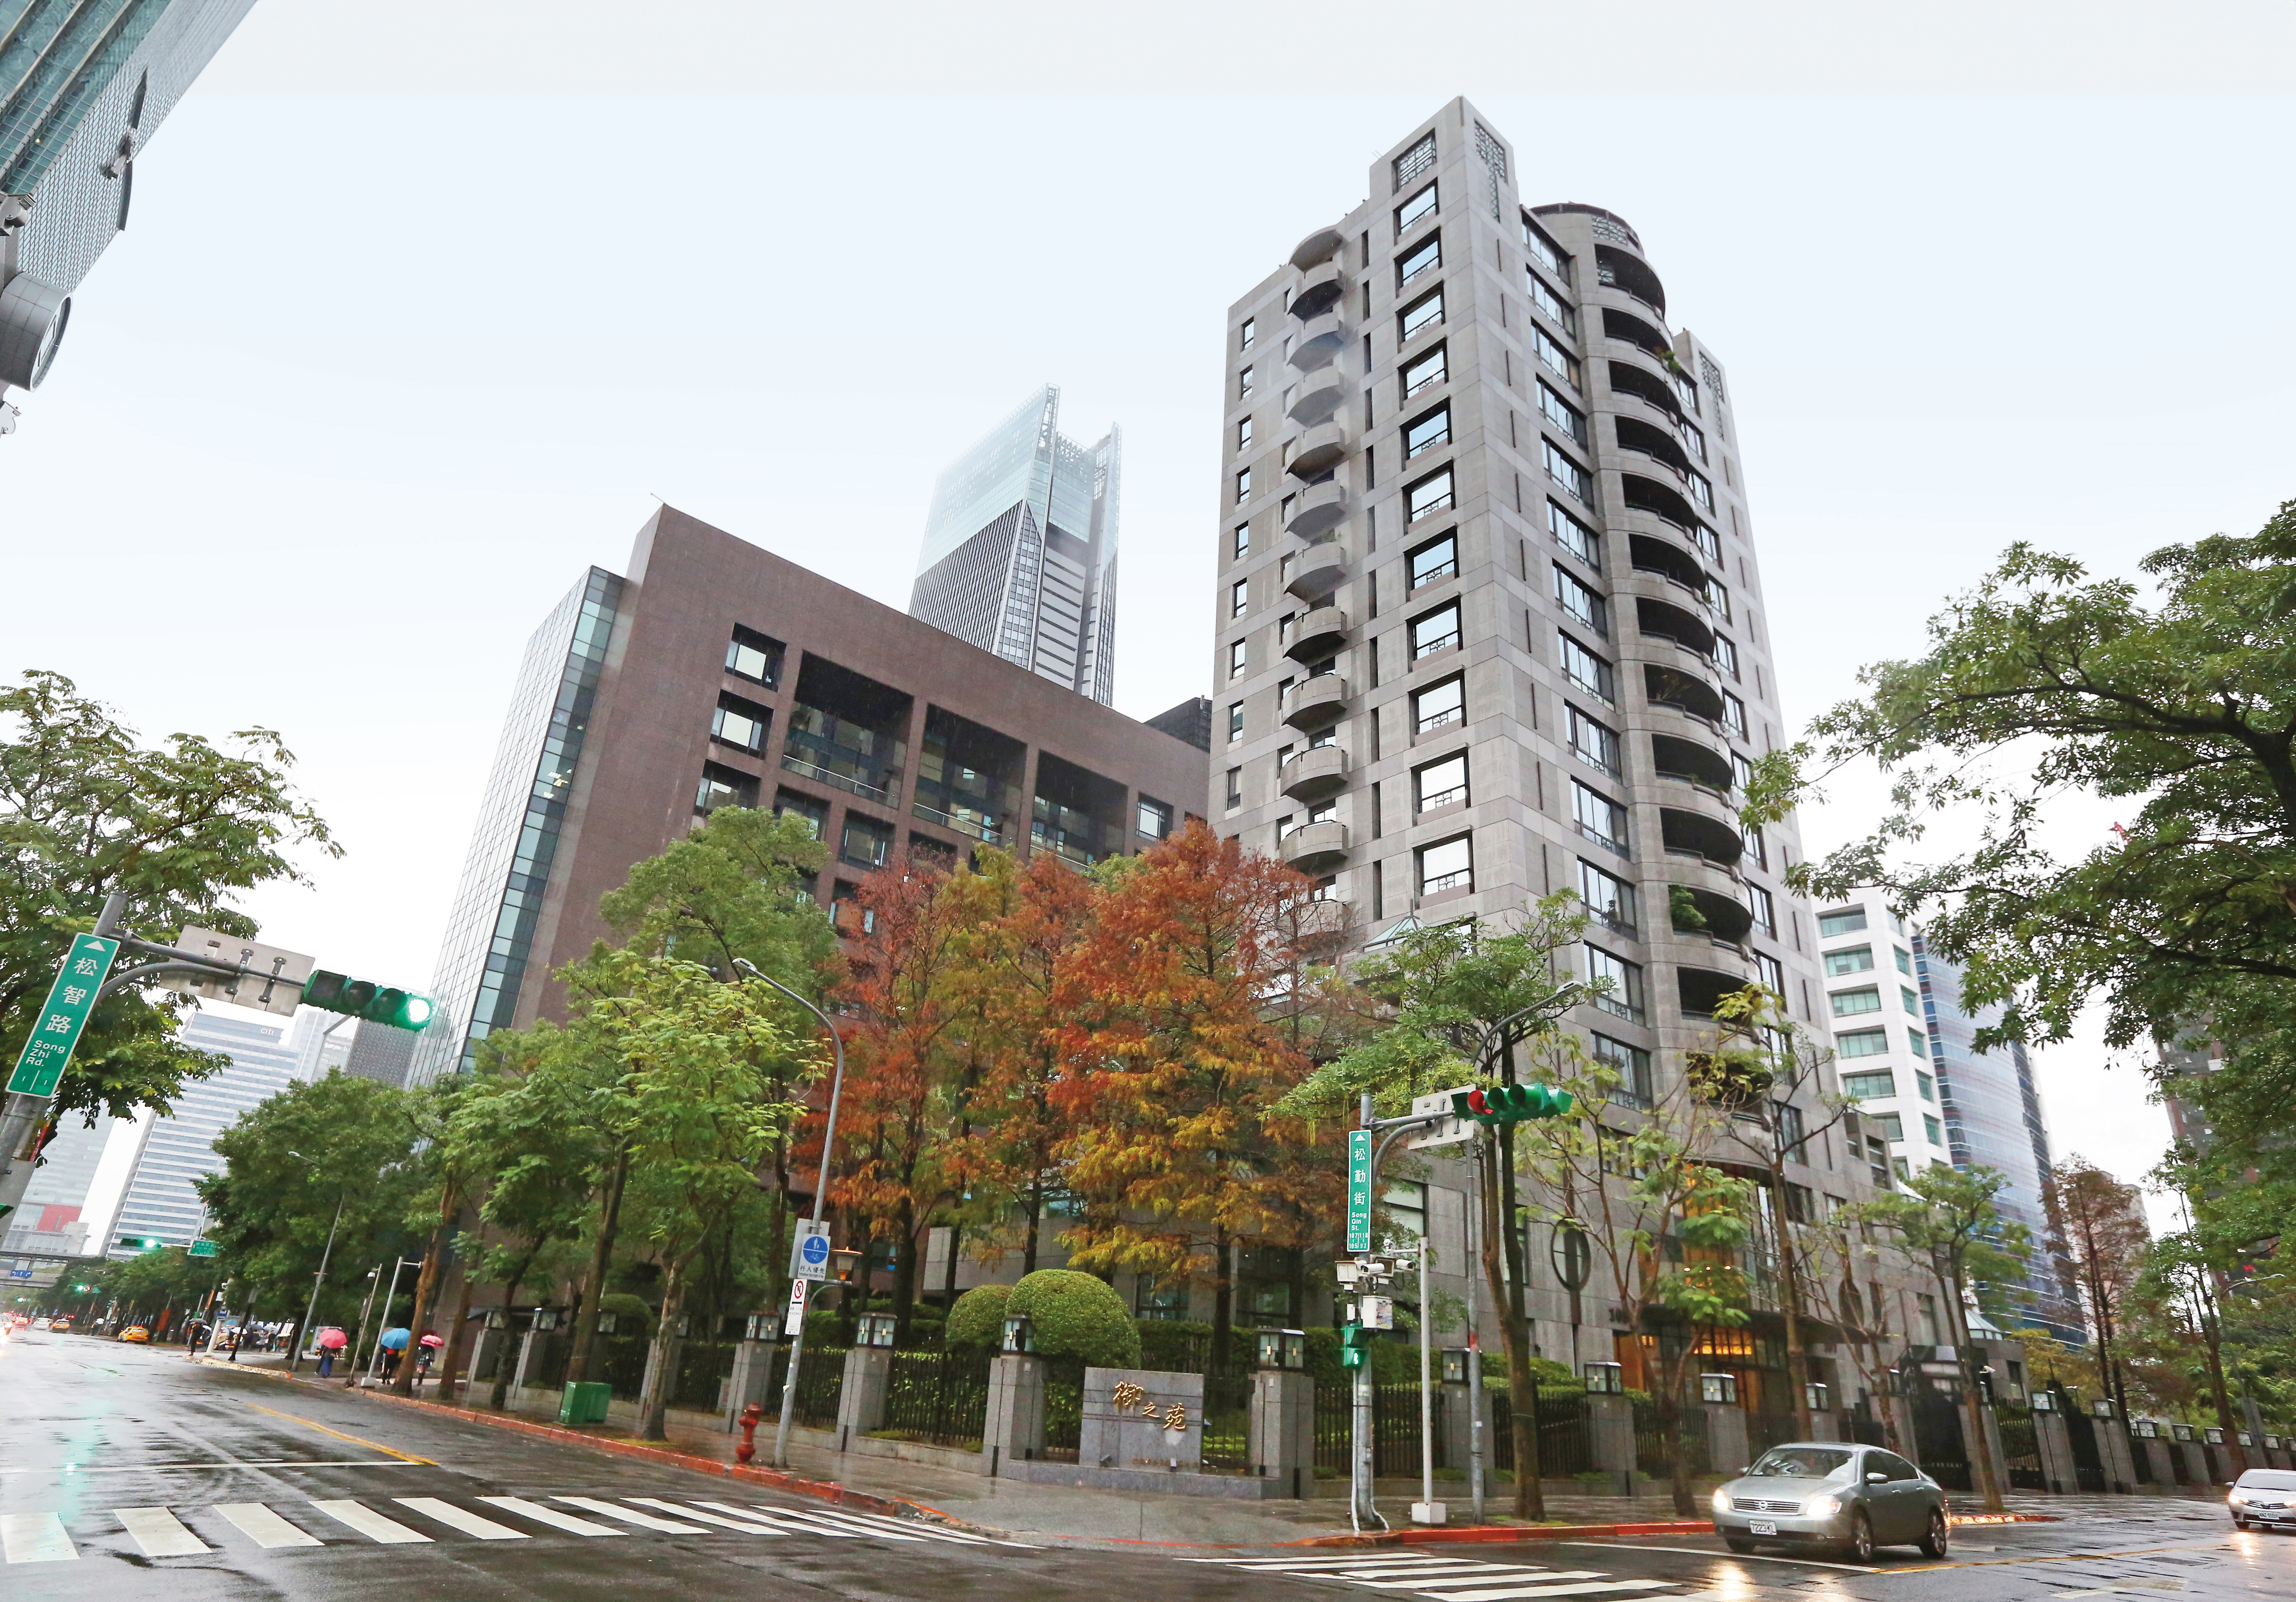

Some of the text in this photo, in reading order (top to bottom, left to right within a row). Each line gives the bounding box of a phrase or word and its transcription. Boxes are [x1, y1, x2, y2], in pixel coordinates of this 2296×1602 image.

[45, 957, 98, 1034] 松智路
[29, 1048, 50, 1058] Zhi
[34, 1040, 66, 1054] Song
[26, 1057, 44, 1067] Rd.
[1354, 1148, 1366, 1205] 松勤街
[800, 1265, 825, 1274] 行人優先
